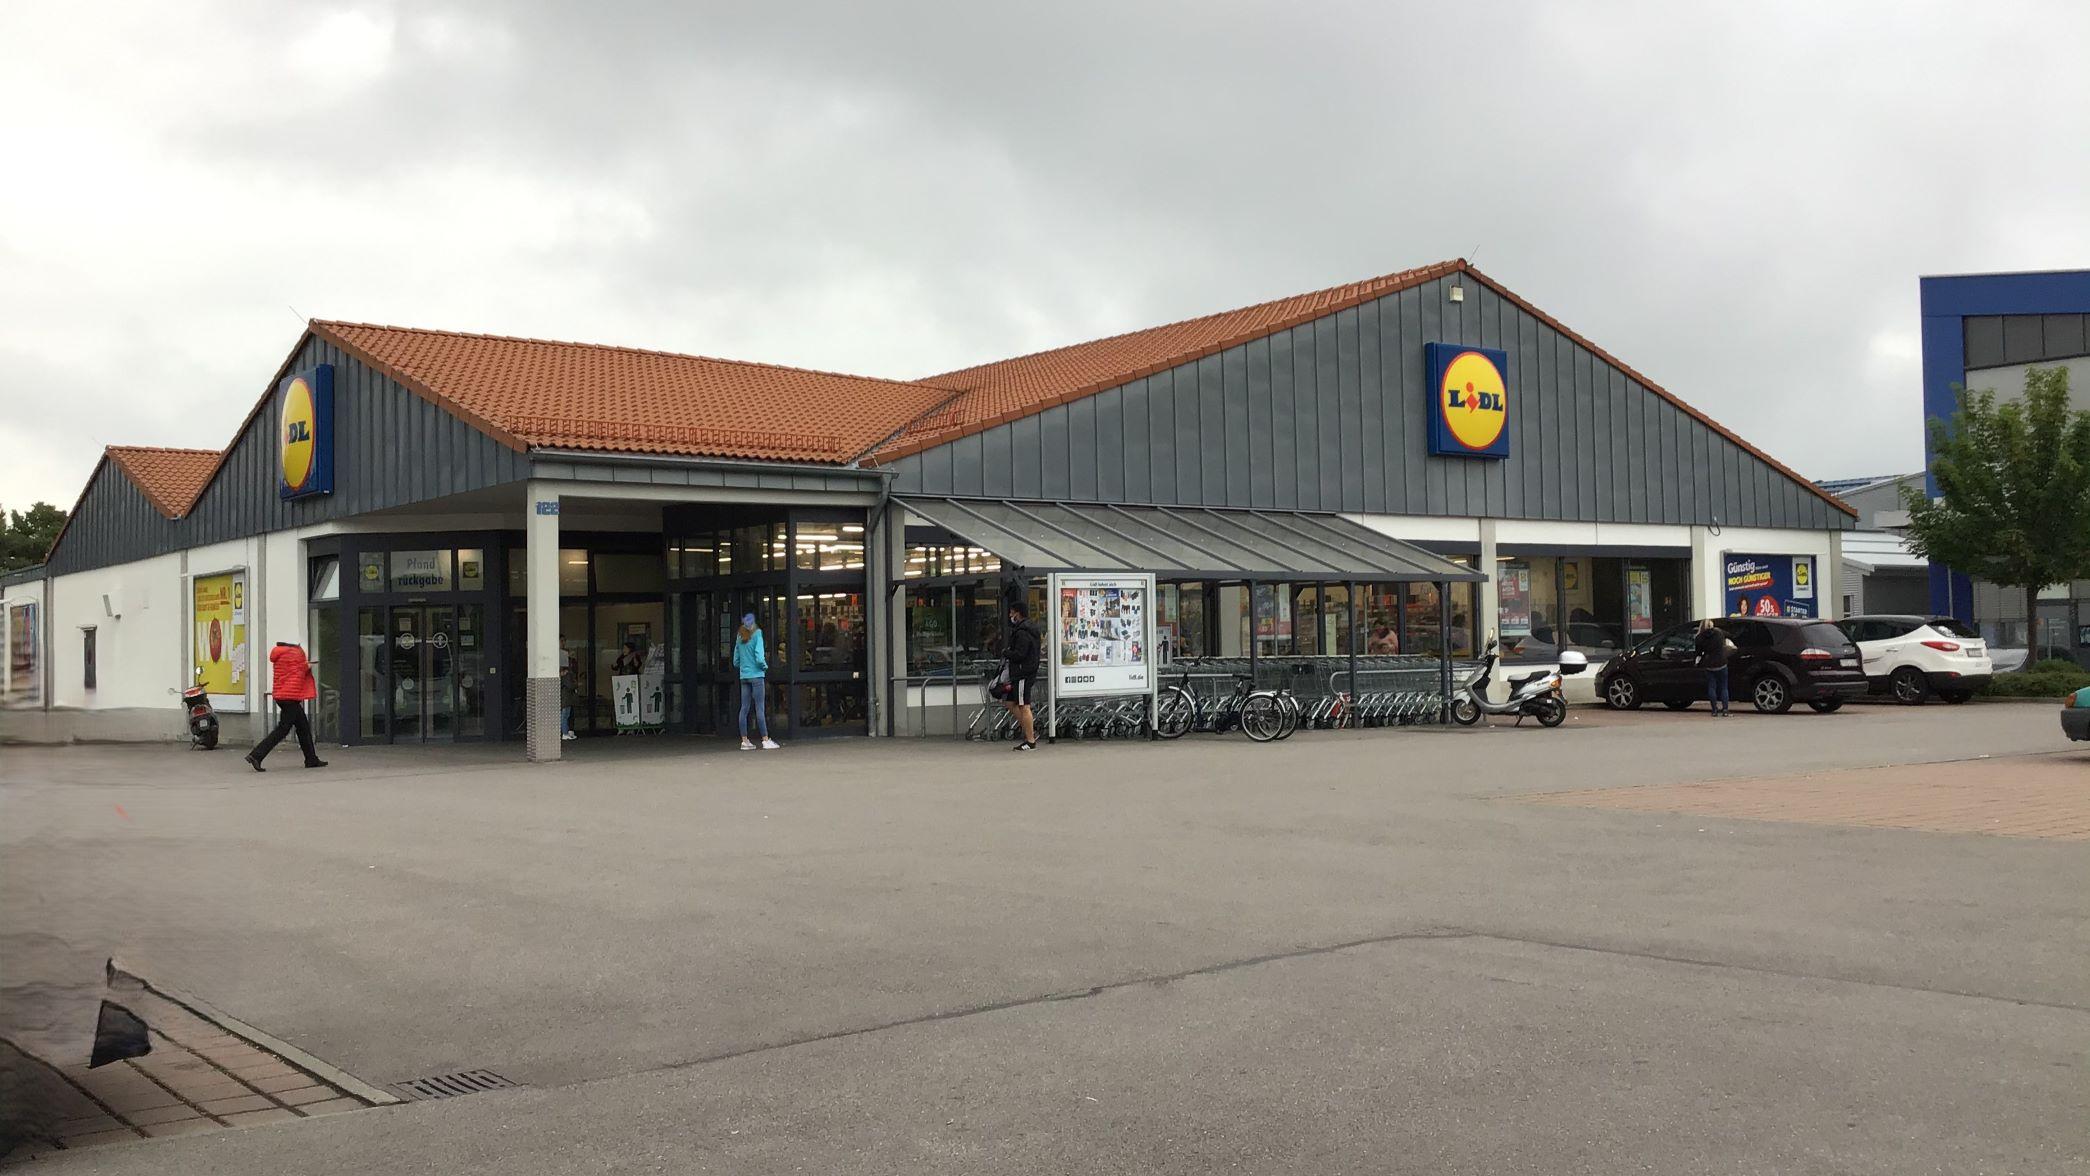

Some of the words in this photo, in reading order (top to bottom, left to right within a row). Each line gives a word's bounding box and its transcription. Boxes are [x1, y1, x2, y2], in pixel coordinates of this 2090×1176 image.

[288, 420, 310, 445] DL
[407, 558, 435, 570] Pfand
[1727, 559, 1756, 574] Günstig
[398, 573, 444, 588] rückgabe
